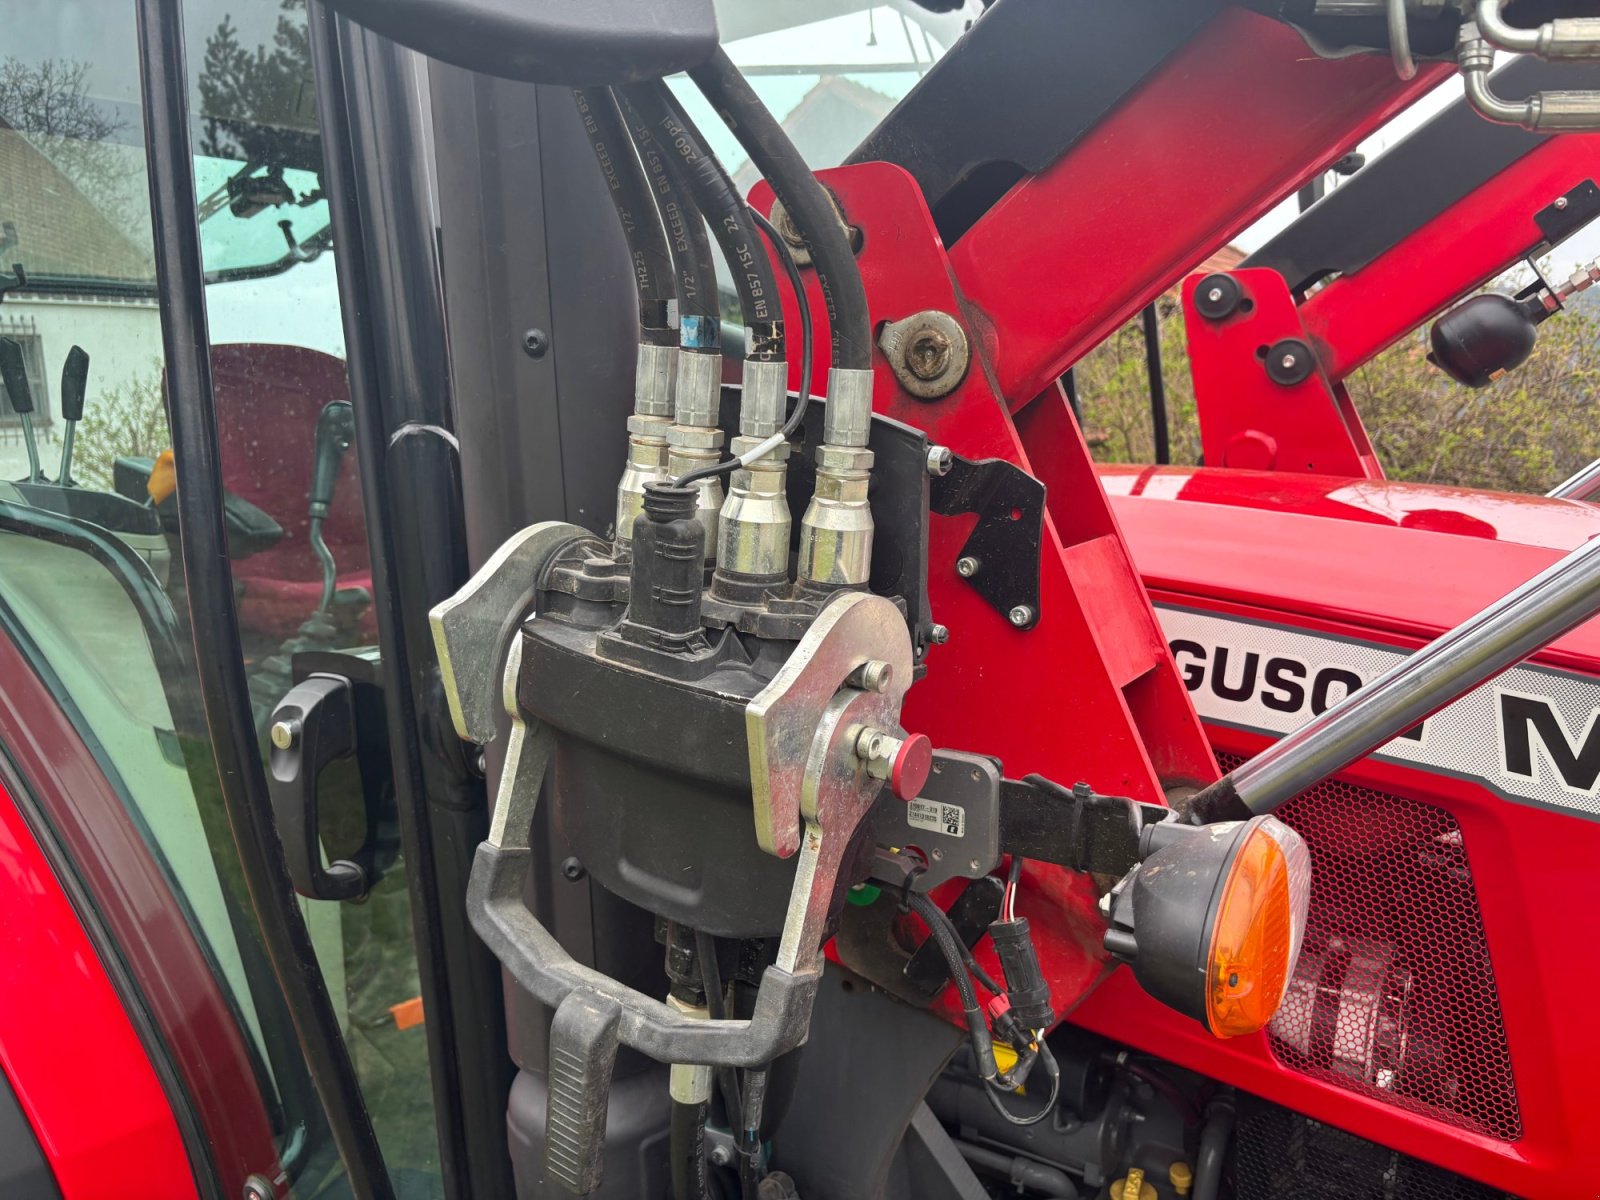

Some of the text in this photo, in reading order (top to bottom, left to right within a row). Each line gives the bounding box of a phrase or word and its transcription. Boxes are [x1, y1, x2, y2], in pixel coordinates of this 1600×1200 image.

[659, 116, 700, 164] 260 psi
[646, 150, 663, 174] 857
[573, 89, 650, 291] TH225 1/2" EXCEED EN 857
[656, 175, 671, 195] EN
[666, 202, 689, 253] EXCEED
[736, 243, 754, 269] 1SC
[682, 270, 697, 299] 1/2"
[747, 273, 763, 297] 857
[754, 299, 768, 319] EN
[819, 273, 837, 321] EXCEED
[832, 350, 840, 368] 85
